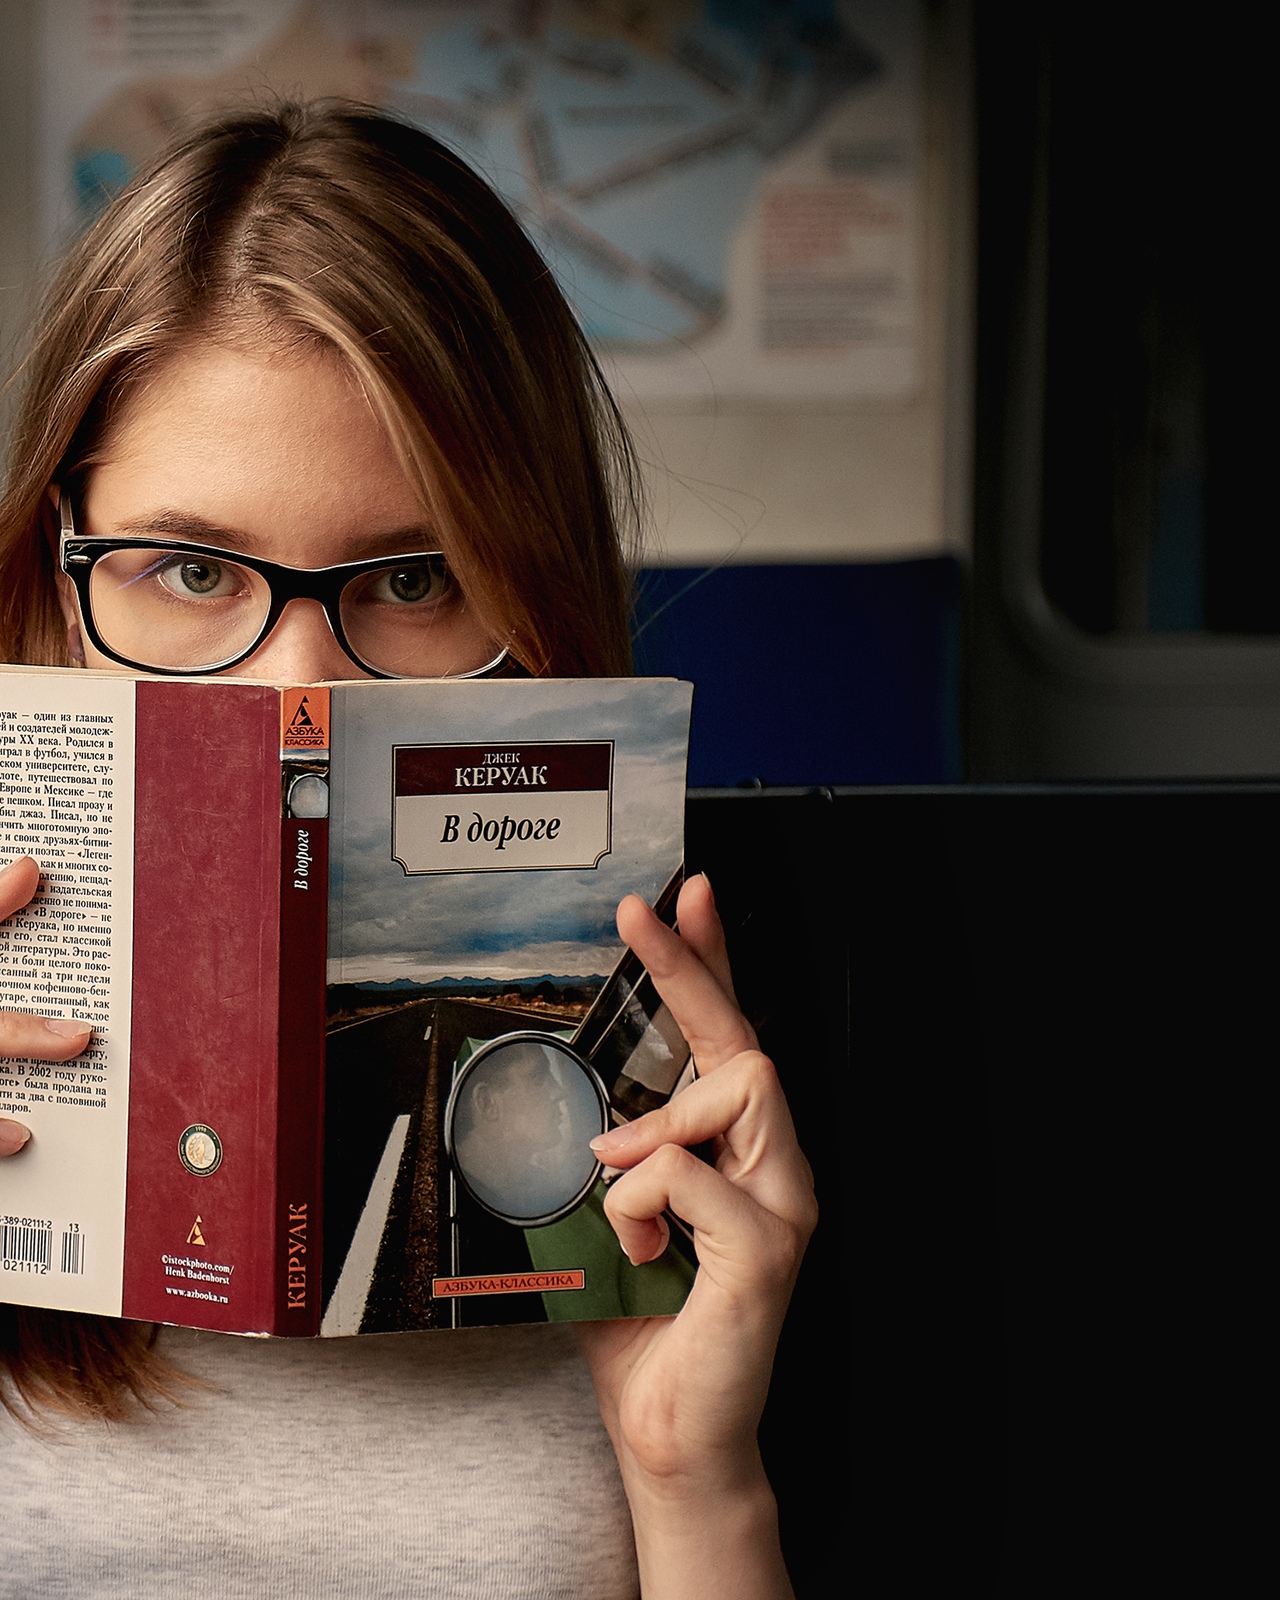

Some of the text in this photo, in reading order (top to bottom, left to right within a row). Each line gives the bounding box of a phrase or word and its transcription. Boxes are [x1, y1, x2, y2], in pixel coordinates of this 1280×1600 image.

[33, 712, 56, 723] один
[60, 713, 71, 722] из
[75, 714, 113, 724] главных
[8, 723, 14, 732] и
[16, 723, 66, 734] создателей
[68, 725, 113, 736] молодеж-
[285, 726, 324, 736] АЗБУКА
[37, 736, 61, 746] века.
[65, 736, 104, 748] Родился
[108, 740, 113, 748] в
[25, 748, 30, 757] в
[33, 747, 70, 761] футбол,
[73, 751, 104, 762] учился
[107, 752, 113, 761] в
[482, 752, 520, 765] ДЖЕК
[25, 760, 90, 774] университете,
[93, 764, 113, 775] слу-
[28, 773, 96, 785] путешествовал
[101, 777, 113, 786] по
[454, 766, 548, 787] КЕРУАК
[0, 782, 32, 795] Европе
[34, 786, 40, 794] и
[43, 784, 84, 797] Мексике
[98, 789, 113, 799] где
[6, 796, 44, 806] пешком.
[47, 797, 76, 809] Писал
[78, 800, 104, 813] прозу
[107, 802, 112, 811] и
[19, 809, 46, 819] джаз.
[50, 809, 82, 823] Писал,
[86, 813, 98, 822] но
[102, 814, 112, 823] не
[27, 822, 90, 836] многотомную
[92, 825, 112, 834] эпо-
[440, 812, 561, 850] В дороге
[4, 833, 10, 842] и
[13, 834, 40, 843] своих
[42, 835, 112, 847] друзьях-битни-
[27, 846, 33, 855] и
[34, 847, 65, 857] поэтах
[76, 847, 112, 859] «Леген-
[294, 829, 312, 890] В дороге
[40, 859, 56, 868] как
[57, 860, 63, 869] и
[64, 860, 96, 871] многих
[98, 862, 112, 871] со-
[79, 874, 112, 886] нещад-
[49, 884, 112, 897] издательская
[62, 898, 73, 907] не
[75, 898, 112, 909] понима-
[33, 906, 46, 917] «В
[48, 909, 86, 921] дороге»
[101, 913, 111, 922] не
[15, 917, 59, 932] Керуака,
[62, 923, 74, 932] но
[77, 924, 111, 934] именно
[13, 931, 32, 942] его,
[36, 932, 58, 942] стал
[62, 935, 111, 947] классикой
[11, 943, 70, 958] литературы.
[72, 946, 90, 957] Это
[91, 949, 111, 960] рас-
[12, 956, 18, 964] и
[21, 954, 45, 966] боли
[48, 958, 81, 969] целого
[84, 961, 110, 971] поко-
[41, 970, 52, 980] за
[55, 972, 73, 983] три
[76, 973, 110, 984] недели
[33, 981, 110, 996] кофеиново-бен-
[30, 994, 90, 1009] спонтанный,
[93, 999, 109, 1009] как
[71, 1009, 109, 1022] Каждое
[79, 1060, 90, 1069] на
[92, 1061, 107, 1070] на-
[17, 1065, 25, 1076] В
[28, 1066, 51, 1078] 2002
[54, 1070, 76, 1082] году
[80, 1072, 107, 1084] руко-
[24, 1078, 48, 1090] была
[52, 1082, 91, 1094] продана
[95, 1086, 106, 1095] на
[15, 1092, 25, 1101] за
[28, 1093, 44, 1103] два
[47, 1094, 53, 1103] с
[56, 1095, 106, 1108] половиной
[68, 1223, 80, 1232] 13
[288, 1202, 308, 1310] КЕРУАК
[3, 1260, 47, 1275] 021112
[165, 1266, 230, 1285] Henk Badenhorst
[443, 1276, 574, 1292] АЗБУКА-КЛАССИКА
[166, 1287, 228, 1304] www.azbooka.ru
